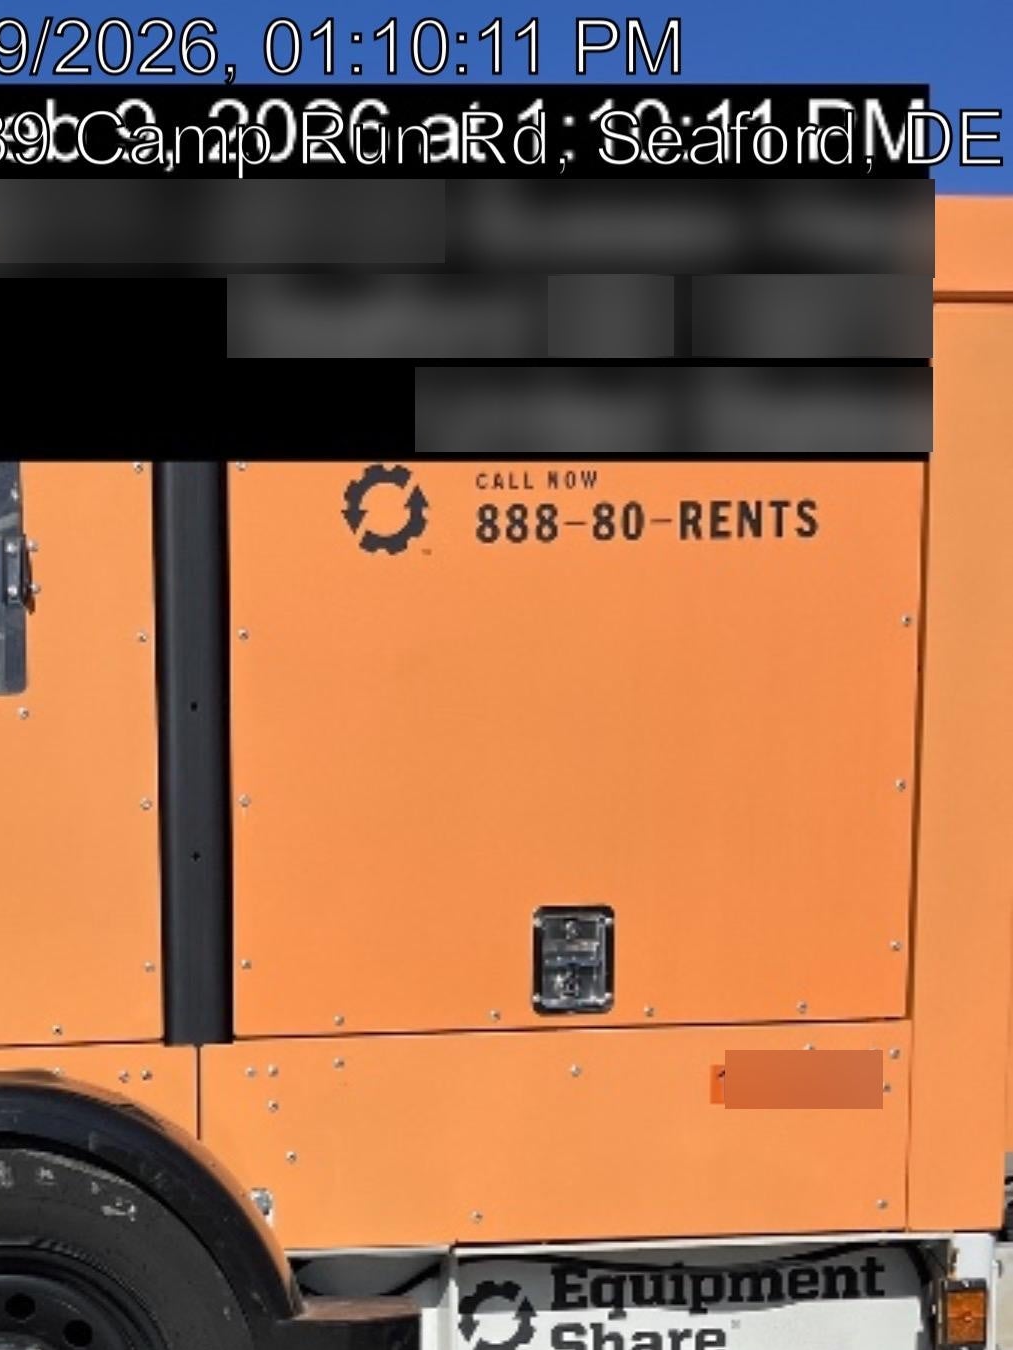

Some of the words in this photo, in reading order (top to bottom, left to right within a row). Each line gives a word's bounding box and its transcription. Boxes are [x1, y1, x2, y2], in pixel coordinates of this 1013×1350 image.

[475, 471, 535, 490] CALL
[547, 470, 599, 489] NOW
[475, 499, 819, 543] 888-80-RENTS
[550, 1257, 886, 1320] Equipment
